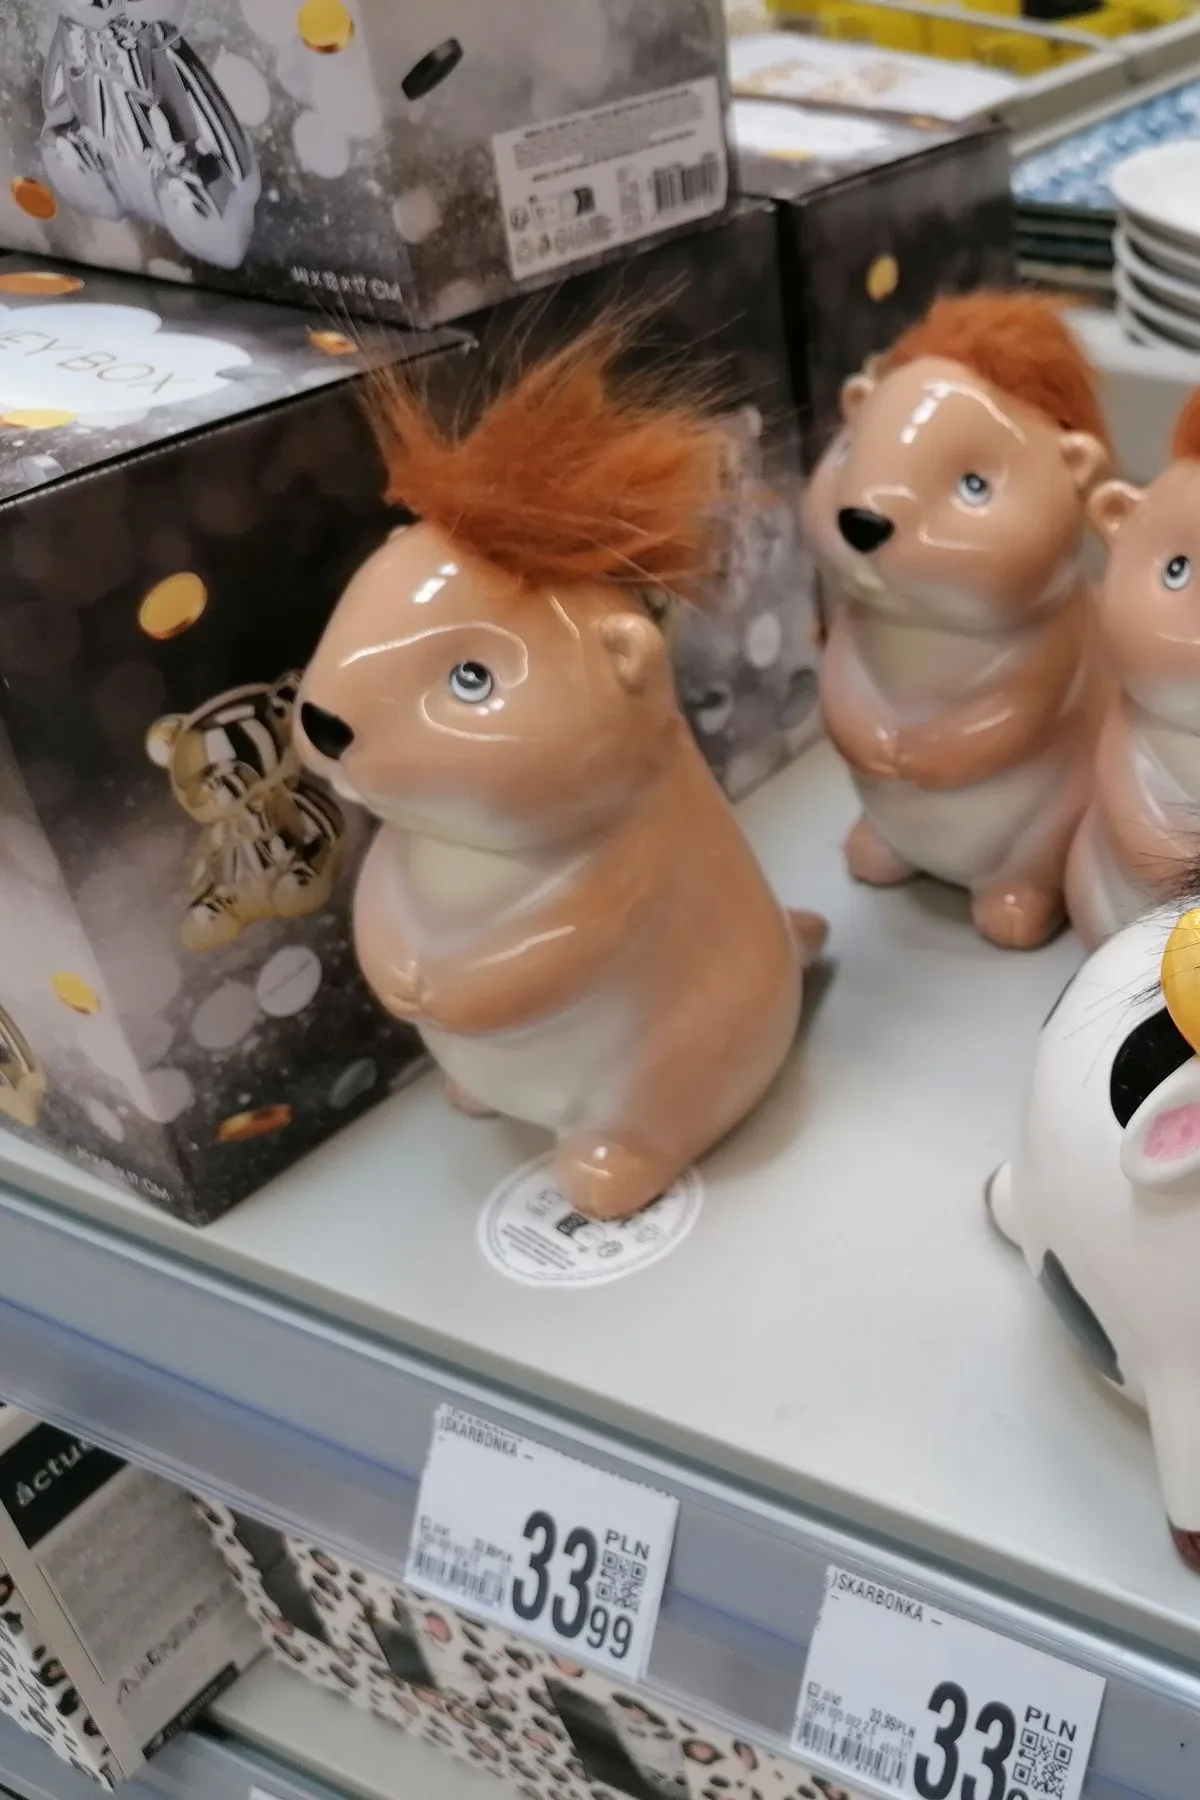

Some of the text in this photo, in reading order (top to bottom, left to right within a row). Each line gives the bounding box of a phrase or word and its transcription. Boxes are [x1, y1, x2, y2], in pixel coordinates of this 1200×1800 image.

[0, 328, 83, 356] EY
[605, 1528, 651, 1560] PLN
[512, 1510, 634, 1660] 33 99
[914, 1680, 1017, 1800] 33
[1024, 1704, 1077, 1742] PLN
